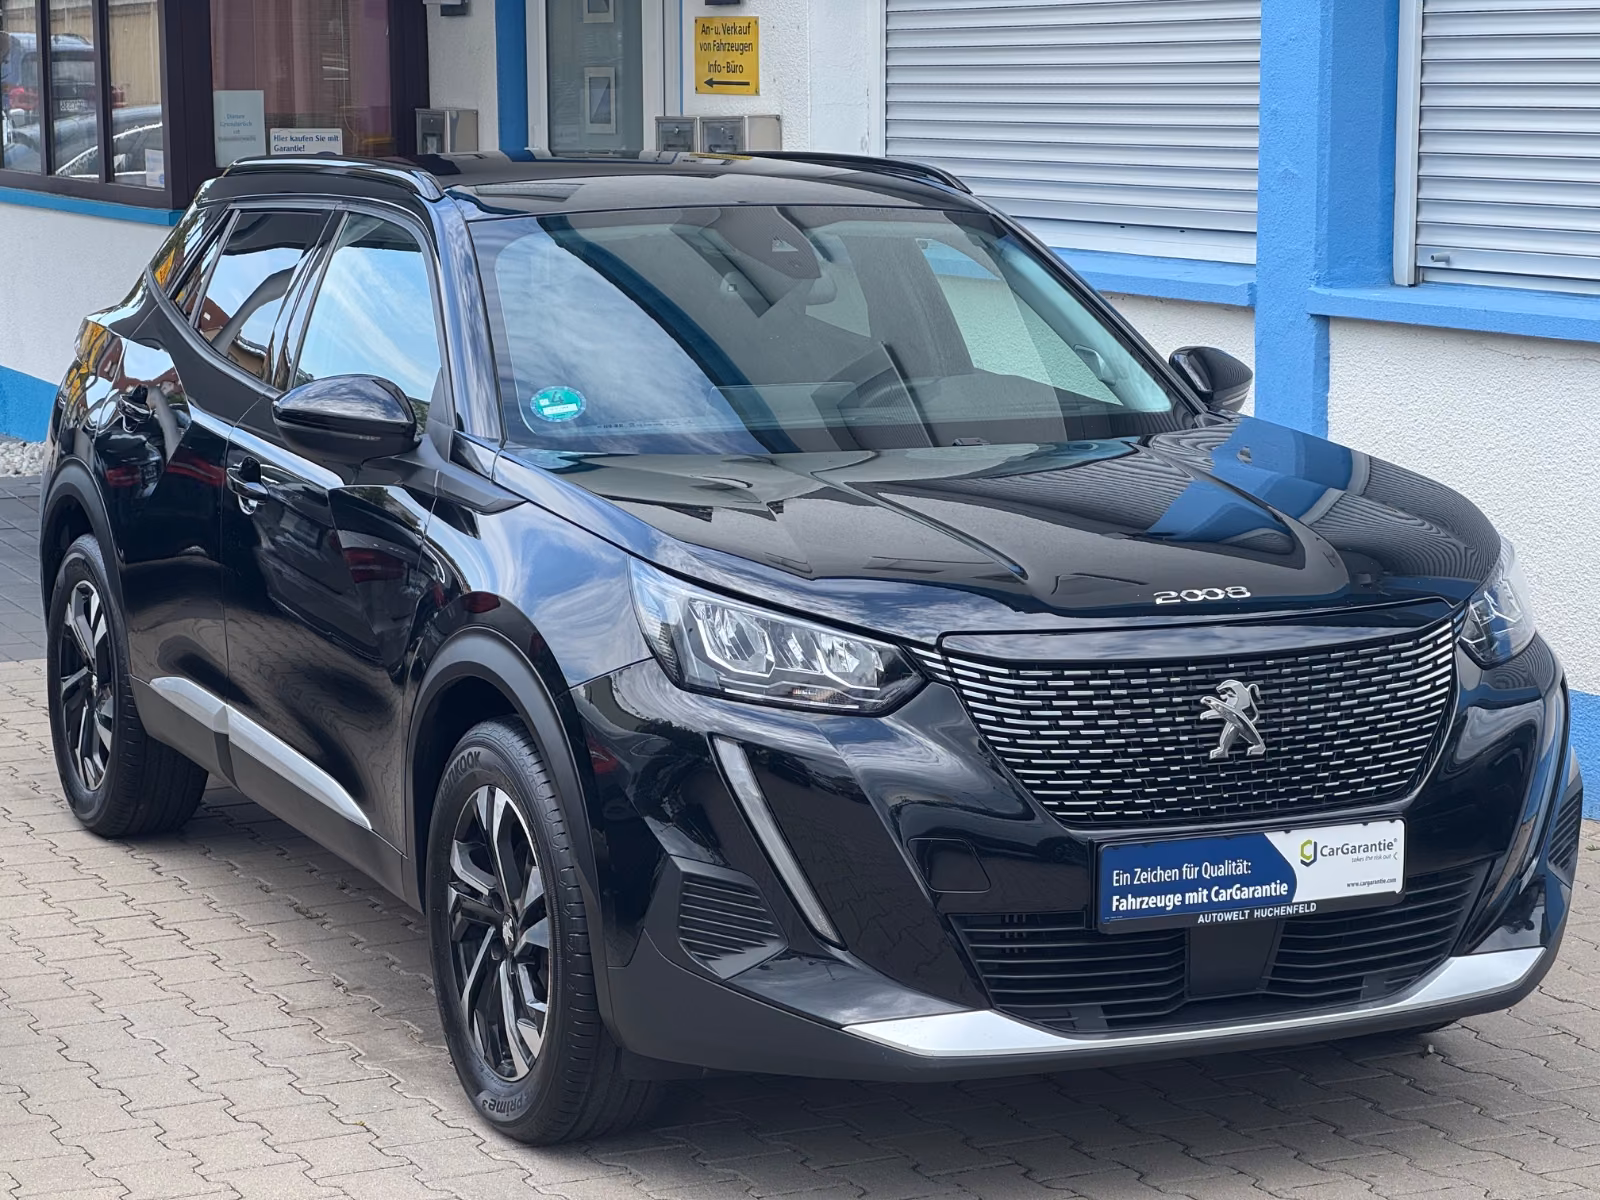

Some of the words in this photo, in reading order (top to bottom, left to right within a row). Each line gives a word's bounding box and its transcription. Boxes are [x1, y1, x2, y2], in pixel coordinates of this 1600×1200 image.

[722, 22, 751, 35] Verkauf
[699, 42, 711, 52] von
[713, 39, 753, 55] Fahrzeugen
[273, 134, 288, 142] Hier
[289, 134, 314, 142] kaufen
[315, 134, 326, 142] Sie
[327, 134, 340, 142] mit
[273, 144, 305, 152] Garantie!
[1153, 586, 1252, 604] 2008
[1112, 869, 1131, 887] Ein
[1133, 866, 1180, 885] Zeichen
[1182, 863, 1200, 880] für
[1201, 859, 1252, 880] Qualität:
[1346, 877, 1397, 888] www.cargarantie.com
[1112, 893, 1183, 912] Fahrzeuge
[1184, 887, 1209, 905] mit
[1210, 880, 1289, 903] CarGarantie
[1197, 909, 1250, 924] AUTOWELT
[1253, 902, 1317, 919] HUCHENFELD
